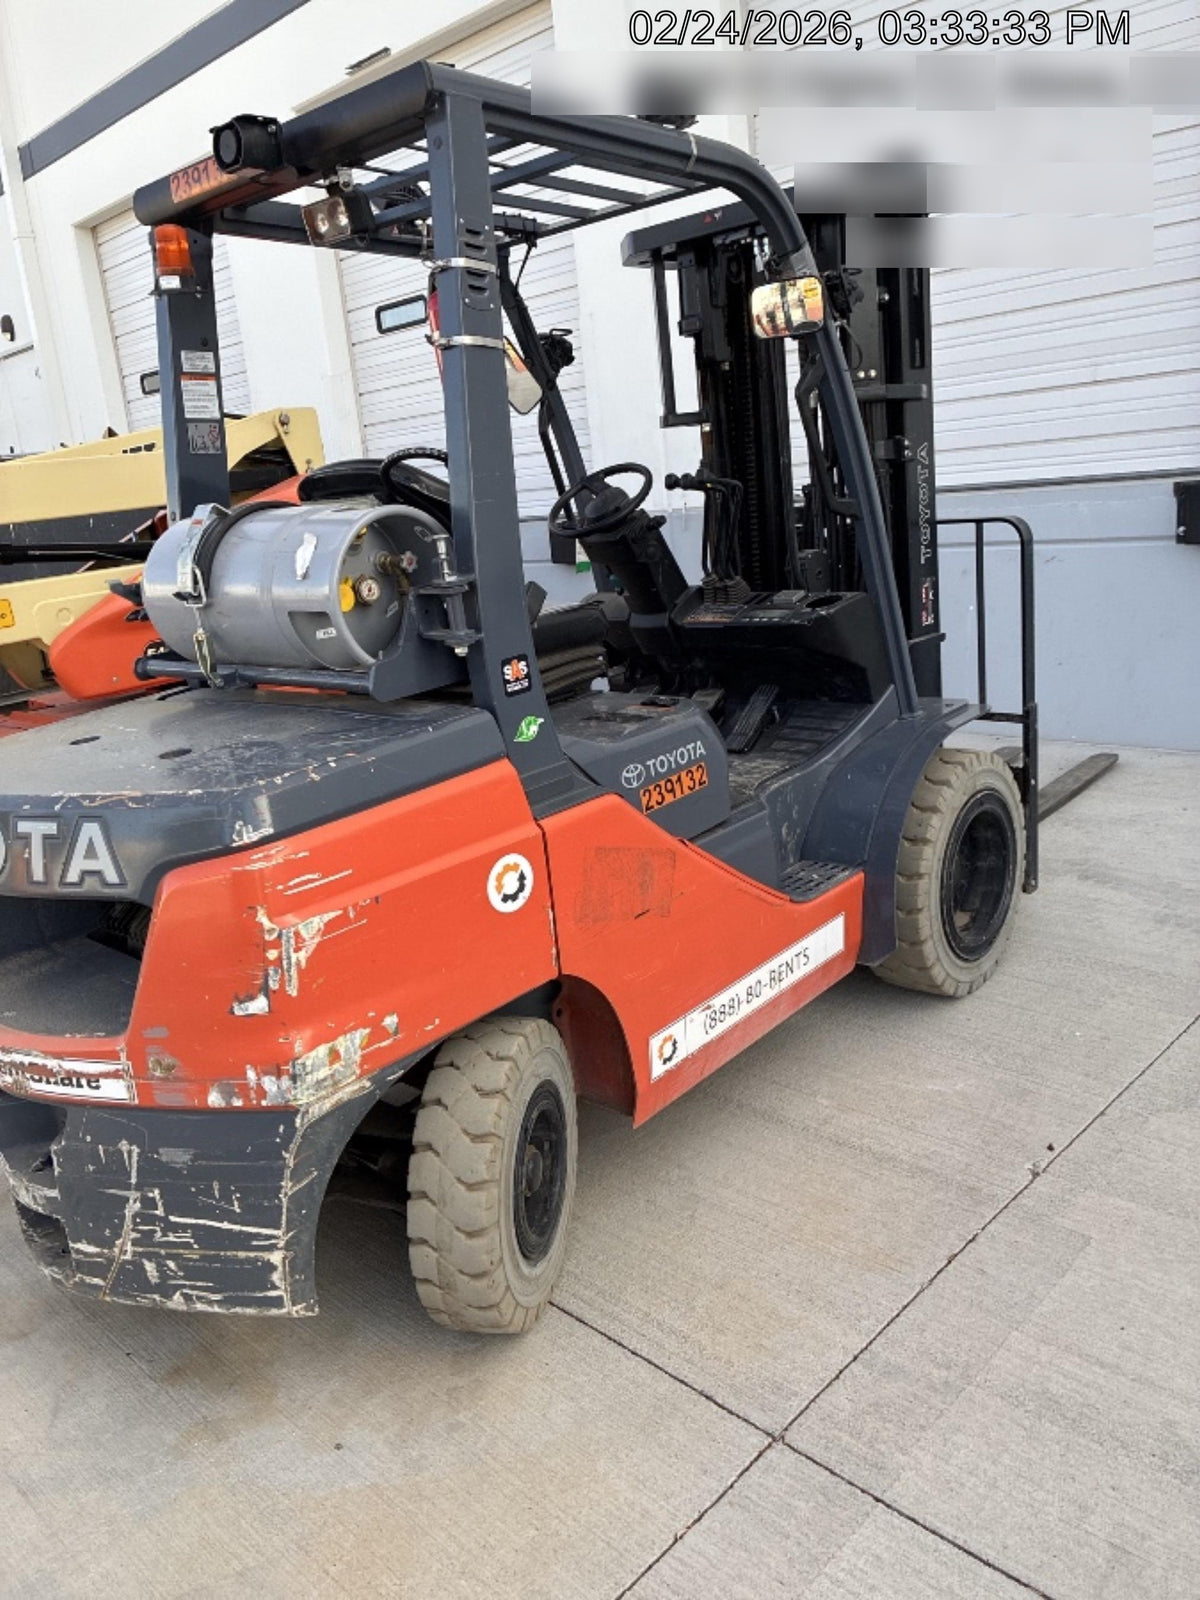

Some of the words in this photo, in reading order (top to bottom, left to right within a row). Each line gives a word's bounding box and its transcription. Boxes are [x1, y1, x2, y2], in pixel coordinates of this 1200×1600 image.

[917, 441, 932, 565] TOYOTA
[646, 740, 706, 777] TOYOTA
[642, 764, 706, 813] 239132
[0, 817, 124, 885] TA
